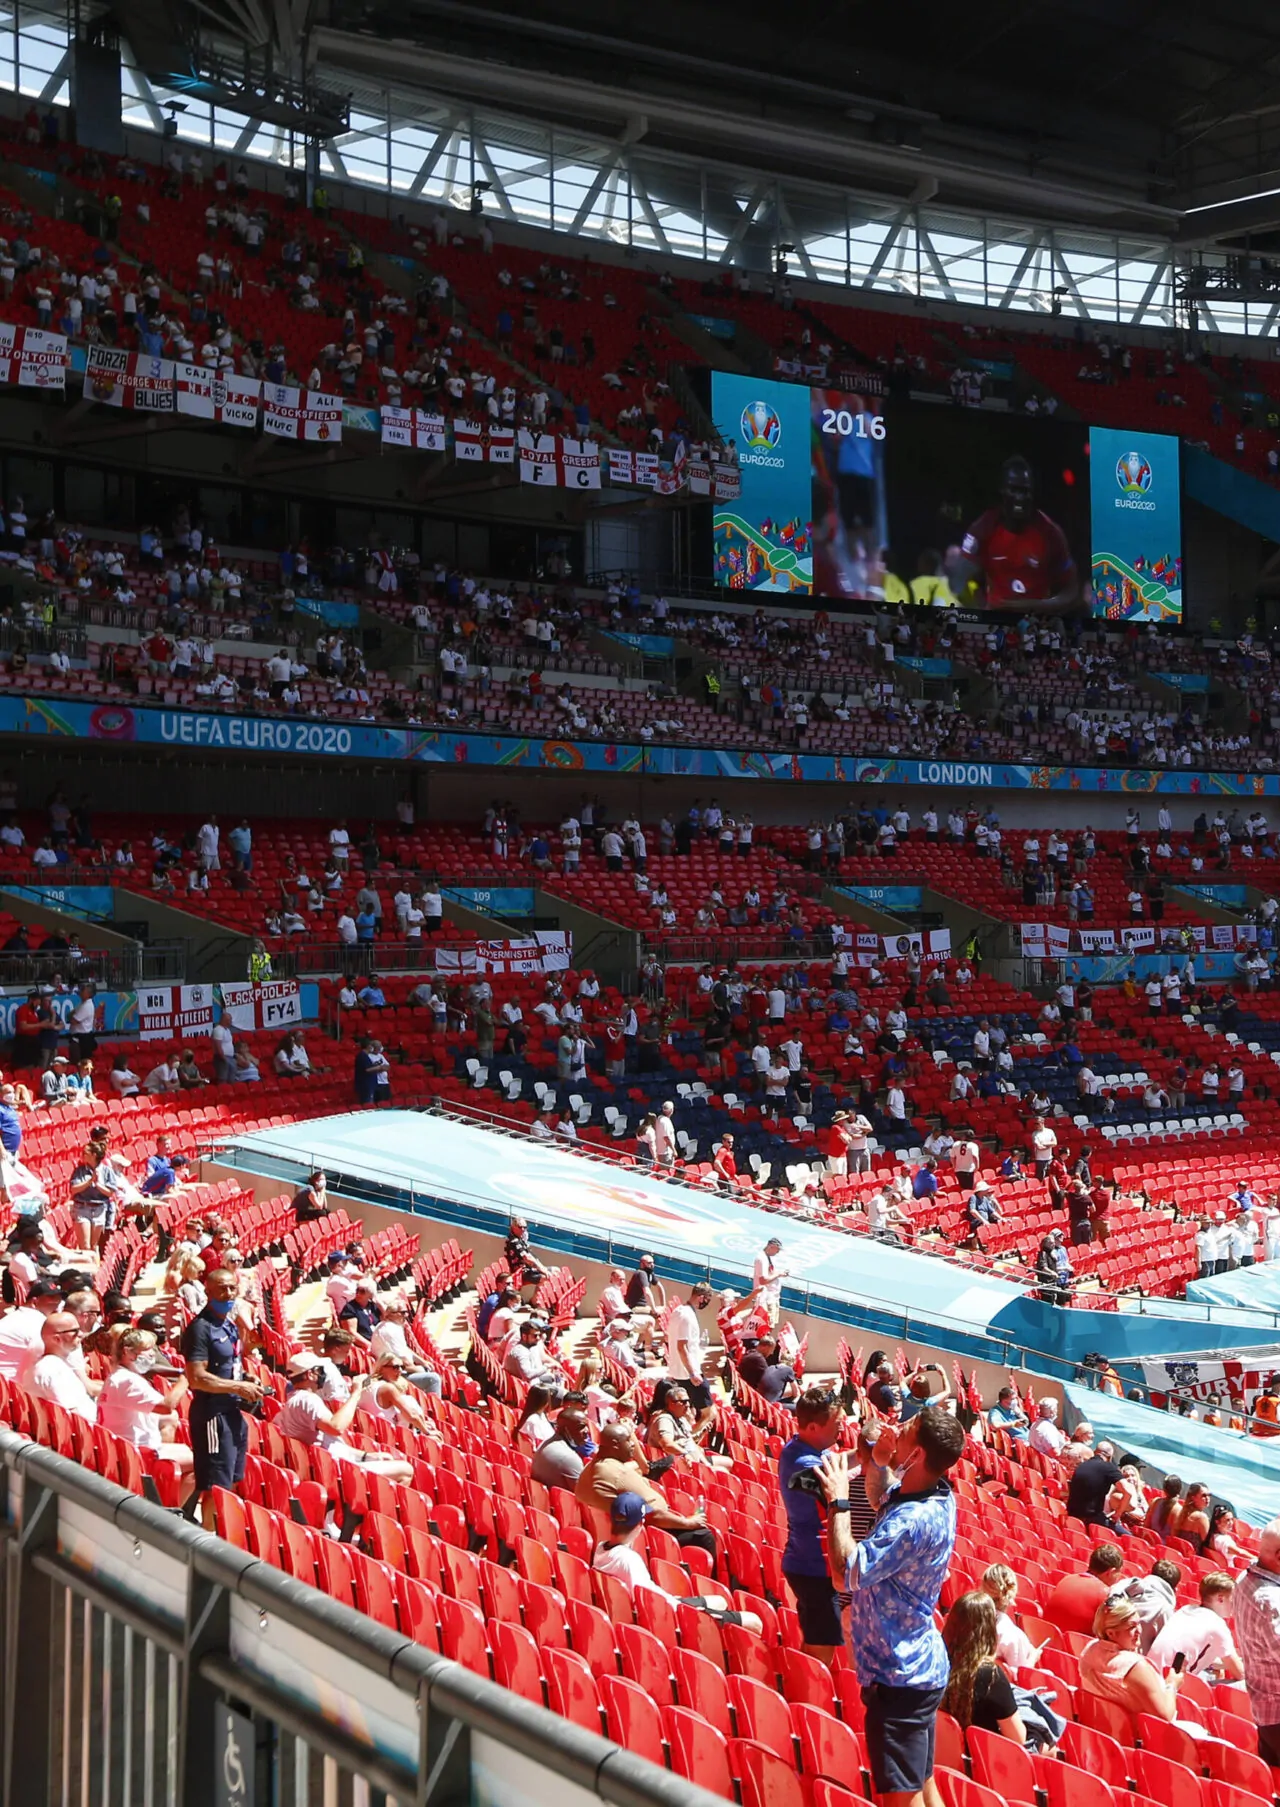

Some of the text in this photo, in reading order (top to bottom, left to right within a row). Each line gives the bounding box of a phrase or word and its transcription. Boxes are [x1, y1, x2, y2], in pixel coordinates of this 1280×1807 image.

[13, 350, 30, 362] ON
[31, 353, 62, 365] TOUR
[90, 346, 128, 371] FORZA
[185, 367, 207, 379] CAJ
[117, 373, 173, 391] GEORGE VALE
[135, 390, 173, 409] BLUES
[317, 397, 334, 406] ALI
[226, 408, 254, 421] VICKO
[269, 404, 338, 420] STOCKSFIELD
[383, 417, 443, 433] BRISTOL ROVERS
[822, 408, 887, 441] 2016
[464, 447, 509, 459] AY WE
[521, 449, 599, 467] LOYAL GREENS
[740, 453, 785, 468] EURO2020
[618, 463, 650, 472] ENGLAND
[533, 466, 590, 487] F C
[1115, 498, 1156, 511] EURO2020
[160, 713, 351, 753] UEFA EURO 2020
[918, 762, 992, 785] LONDON
[46, 890, 65, 902] 108
[473, 891, 491, 902] 109
[869, 889, 884, 898] 110
[858, 936, 877, 945] HA1
[147, 996, 165, 1008] MCR
[267, 1000, 295, 1021] FY4
[144, 1010, 210, 1029] WIGAN ATHLETIC
[1178, 1376, 1247, 1401] BURY
